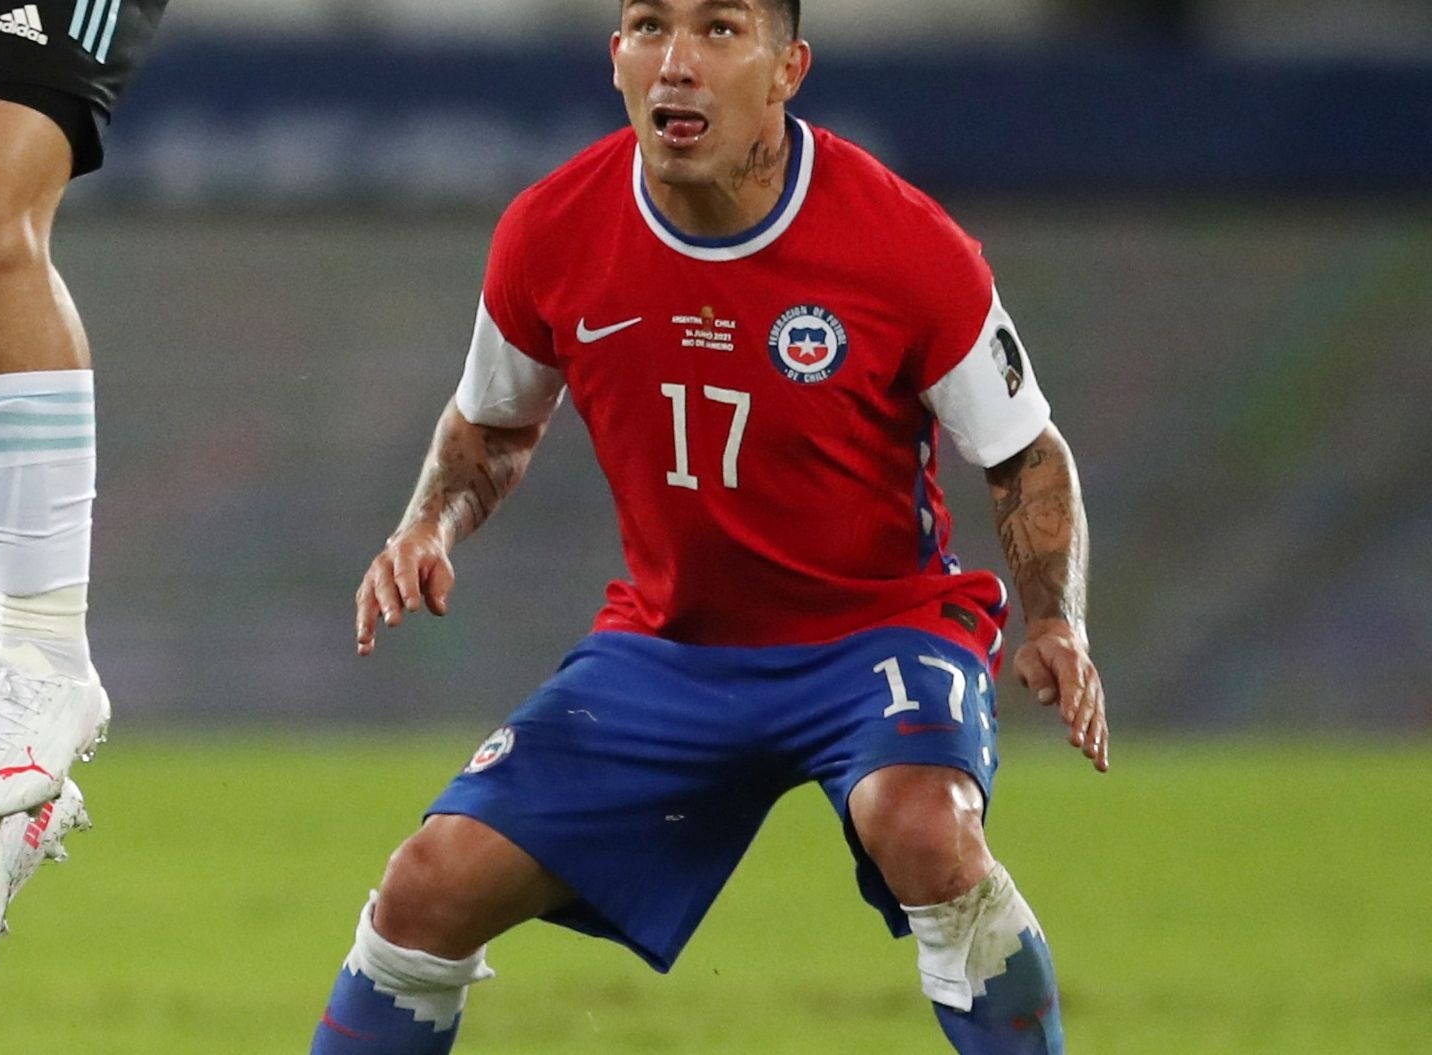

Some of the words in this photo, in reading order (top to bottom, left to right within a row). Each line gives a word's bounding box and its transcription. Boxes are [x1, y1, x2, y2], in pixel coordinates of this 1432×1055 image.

[812, 306, 825, 319] DE
[714, 319, 736, 329] CHILE
[681, 339, 695, 347] RIO
[695, 339, 705, 348] DE
[787, 369, 799, 381] DE
[803, 370, 829, 383] CHILE
[661, 383, 751, 490] 17
[873, 655, 966, 724] 17
